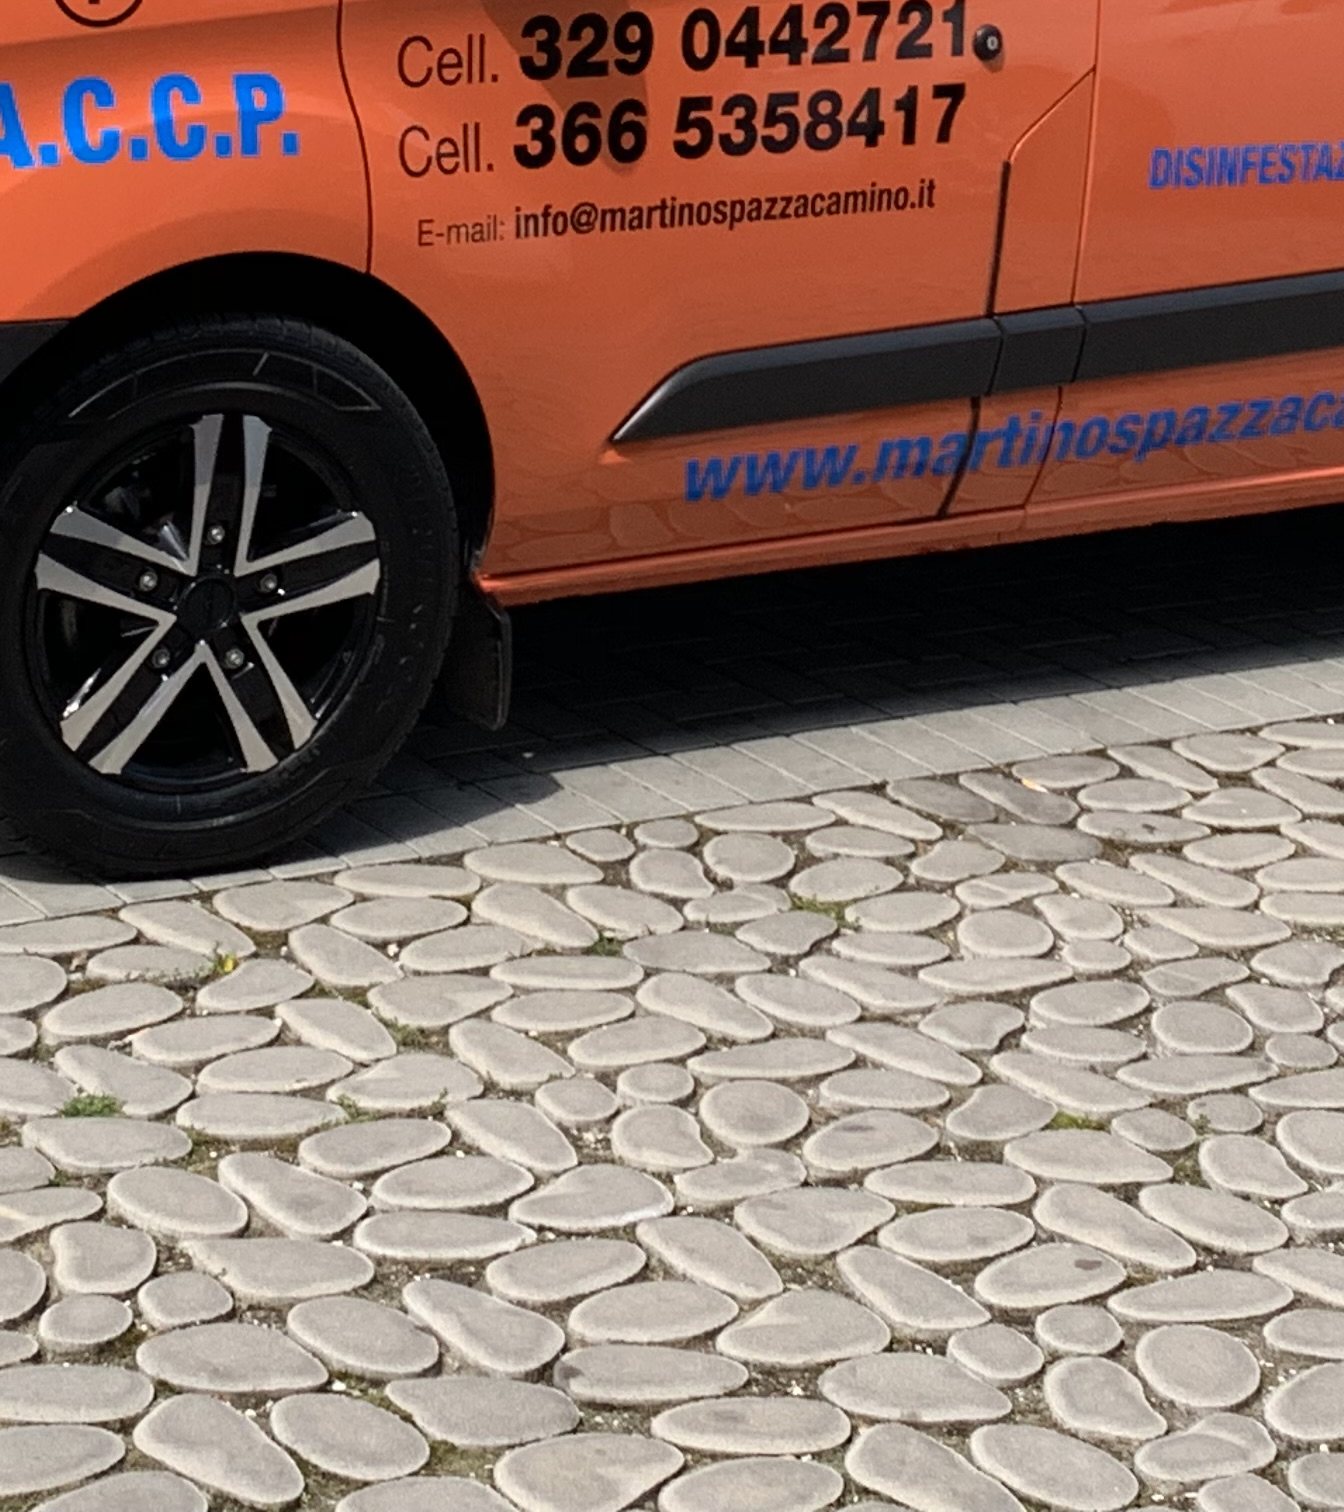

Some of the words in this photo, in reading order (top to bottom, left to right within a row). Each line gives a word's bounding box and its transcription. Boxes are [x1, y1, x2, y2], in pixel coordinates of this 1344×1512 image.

[398, 32, 499, 88] Cell.
[519, 10, 654, 83] 329
[398, 121, 495, 178] Cell.
[513, 99, 649, 170] 366
[672, 82, 968, 160] 5358417
[416, 216, 505, 247] E-mail:
[514, 178, 937, 241] info@martinospazzacamino.it
